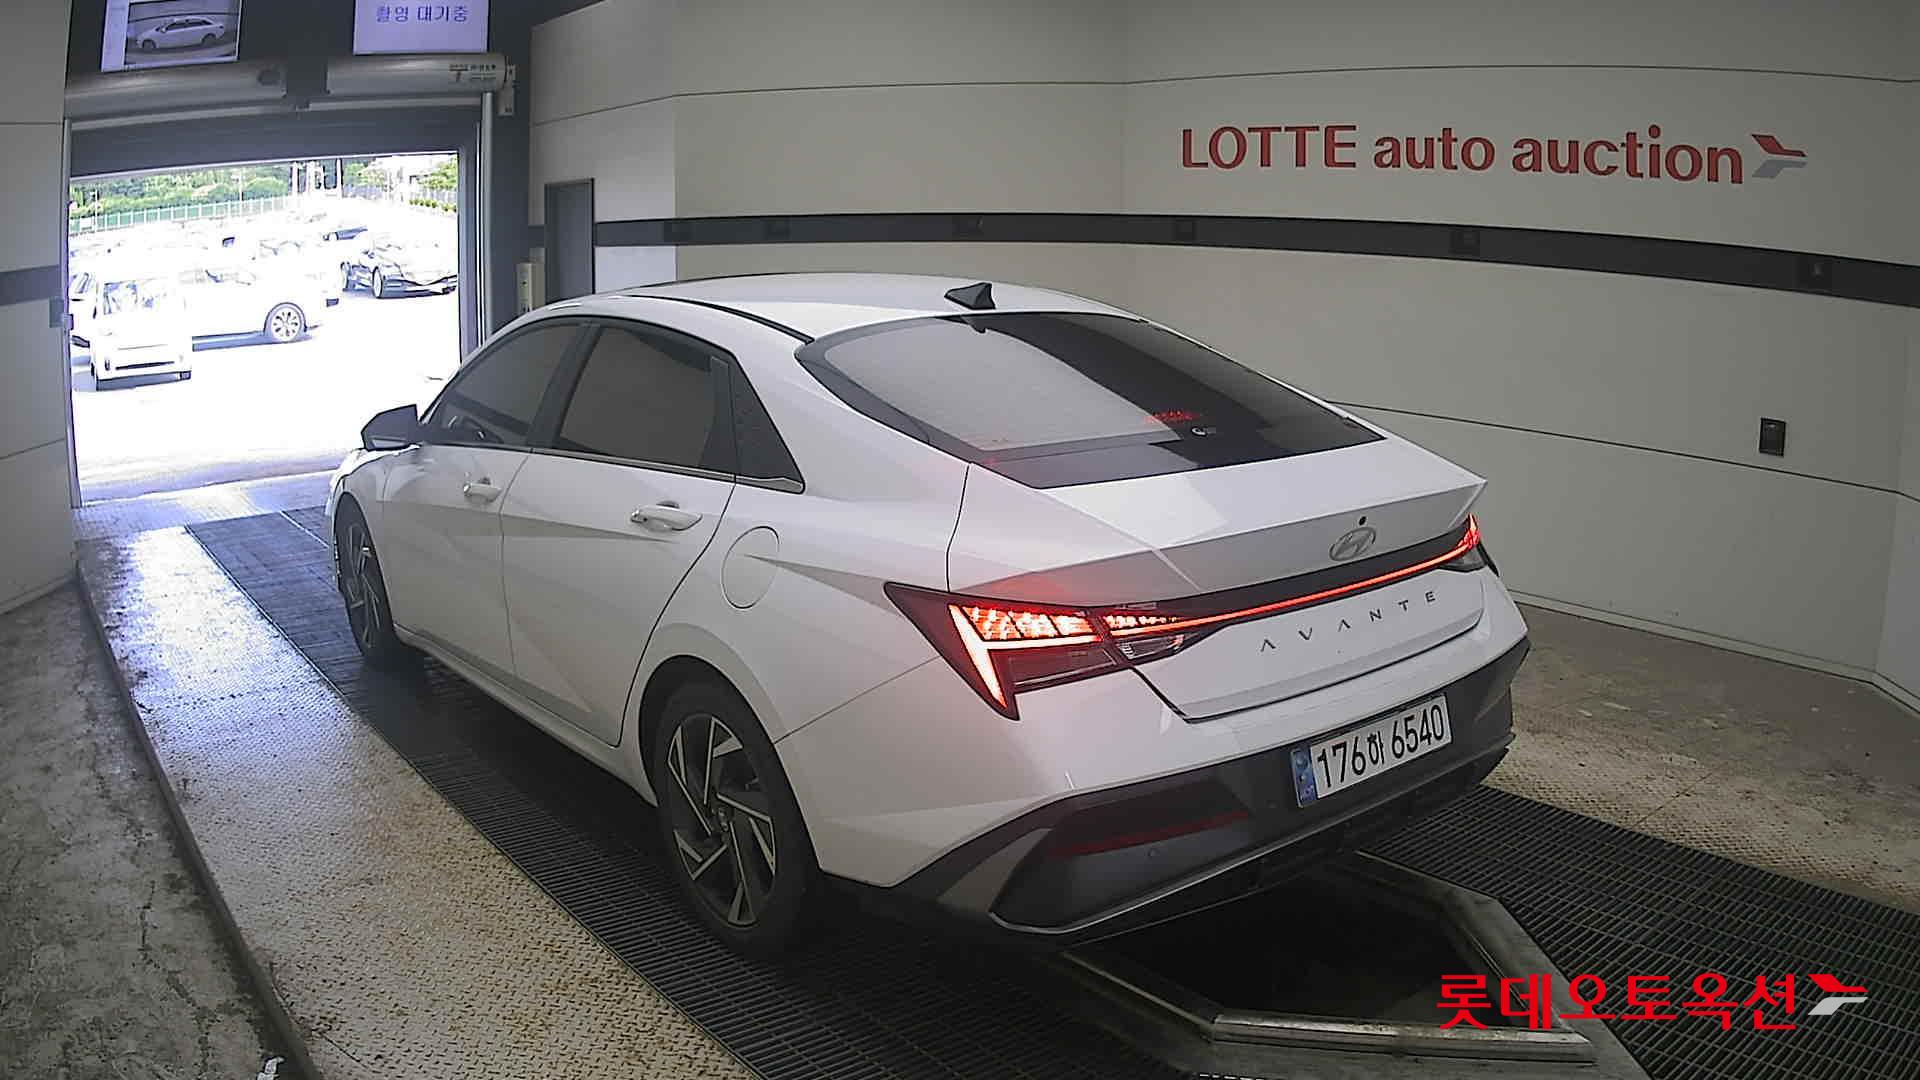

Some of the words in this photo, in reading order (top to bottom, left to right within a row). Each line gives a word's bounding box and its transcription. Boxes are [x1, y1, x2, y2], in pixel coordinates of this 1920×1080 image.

[417, 4, 468, 23] 대기중
[1182, 125, 1357, 168] LOTTE
[1374, 127, 1496, 171] auto
[1512, 124, 1743, 184] auction
[1260, 591, 1436, 652] AVANTE
[1317, 730, 1385, 788] 176하
[1391, 704, 1445, 759] 6540
